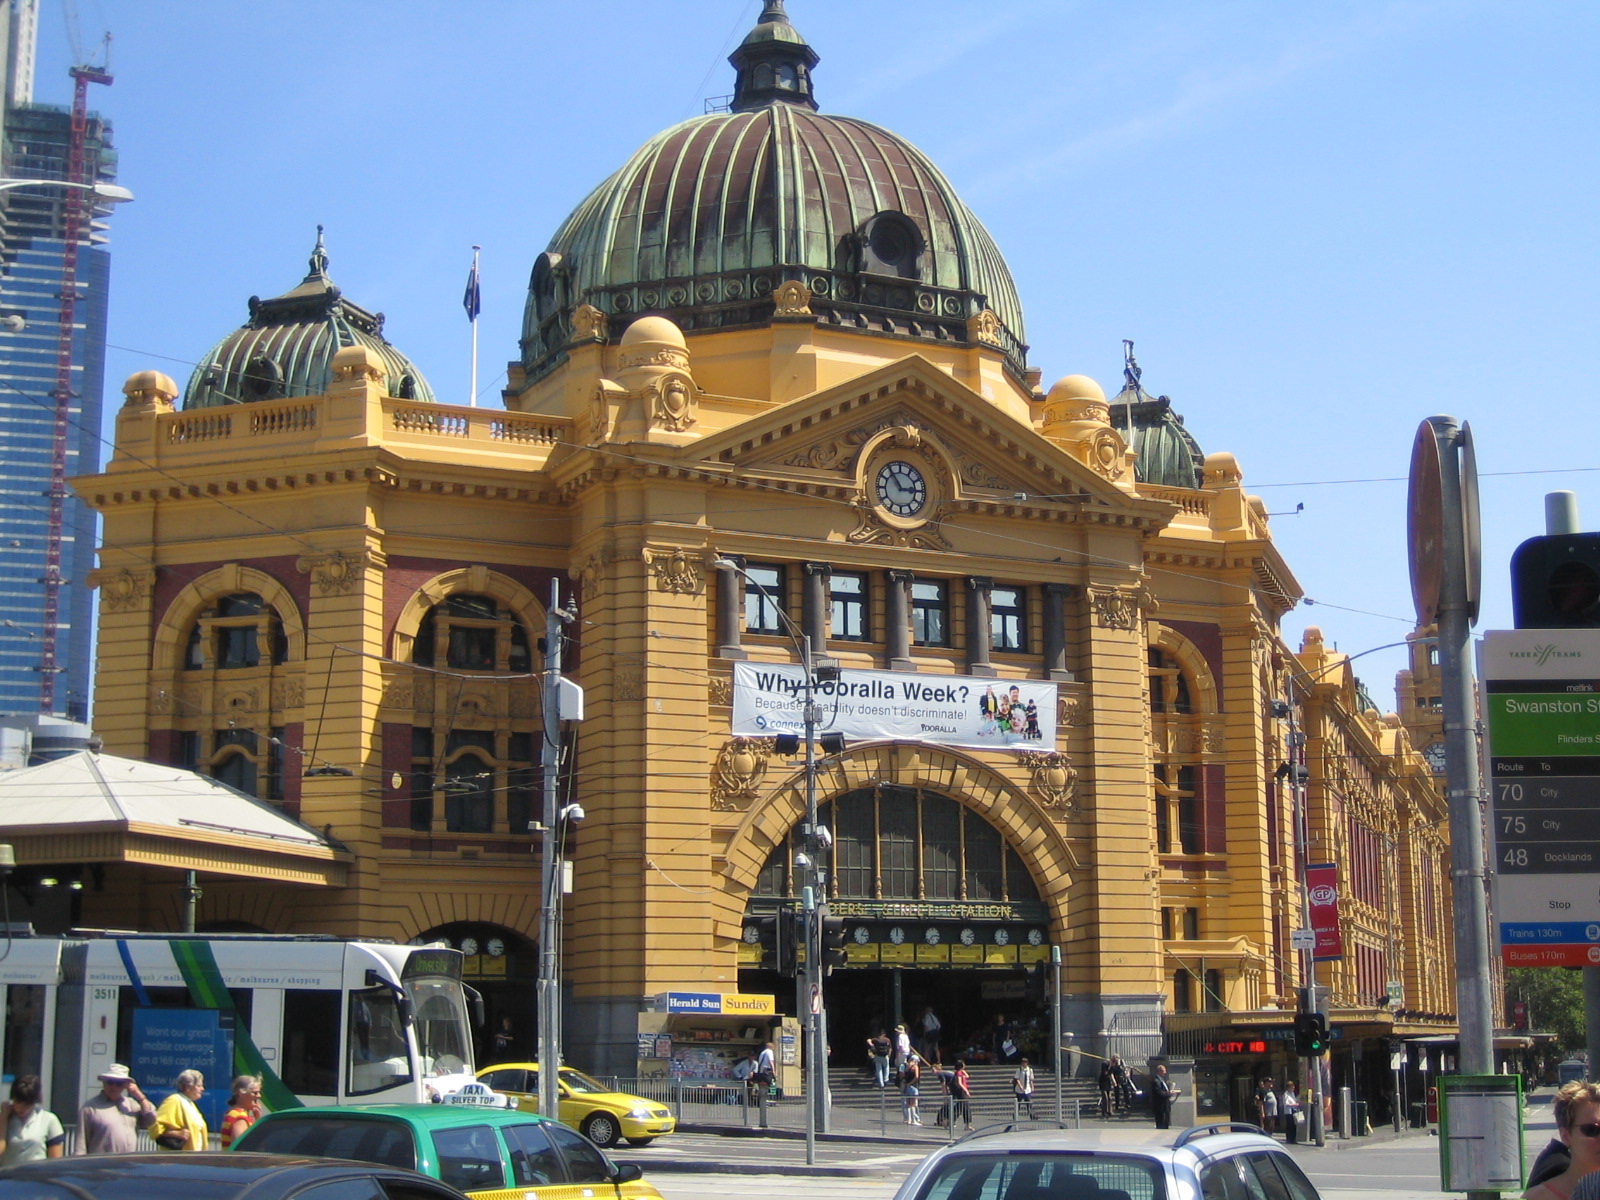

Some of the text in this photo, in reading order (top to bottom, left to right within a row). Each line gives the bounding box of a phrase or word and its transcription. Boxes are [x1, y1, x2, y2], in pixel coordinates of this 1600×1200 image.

[756, 672, 969, 703] Why Yooralla Week?
[1566, 683, 1594, 692] metlink
[755, 697, 802, 710] Because
[858, 704, 897, 717] doesn't
[900, 706, 968, 720] discriminate!
[1505, 699, 1582, 713] Swanston
[1557, 734, 1593, 744] Flinders
[1497, 762, 1551, 772] Route To
[1499, 784, 1559, 801] 70 City
[1502, 816, 1561, 834] 75 City
[1503, 848, 1592, 866] 48 Docklands
[1315, 890, 1329, 899] GP
[794, 901, 1012, 917] FDERS STREET STATION
[1549, 900, 1571, 909] Stop
[1508, 928, 1562, 938] Trains 130m
[1510, 950, 1566, 960] Buses 170m
[240, 975, 279, 984] melbourne
[287, 977, 321, 985] shopping
[94, 988, 117, 1000] 3511
[669, 998, 720, 1009] Herald Sun
[725, 998, 770, 1012] Sunday
[146, 1027, 212, 1041] Want our great
[143, 1041, 173, 1051] mobile
[175, 1058, 191, 1069] cap
[147, 1075, 168, 1085] Now
[463, 1085, 484, 1095] TAXI
[451, 1096, 476, 1104] SILVER
